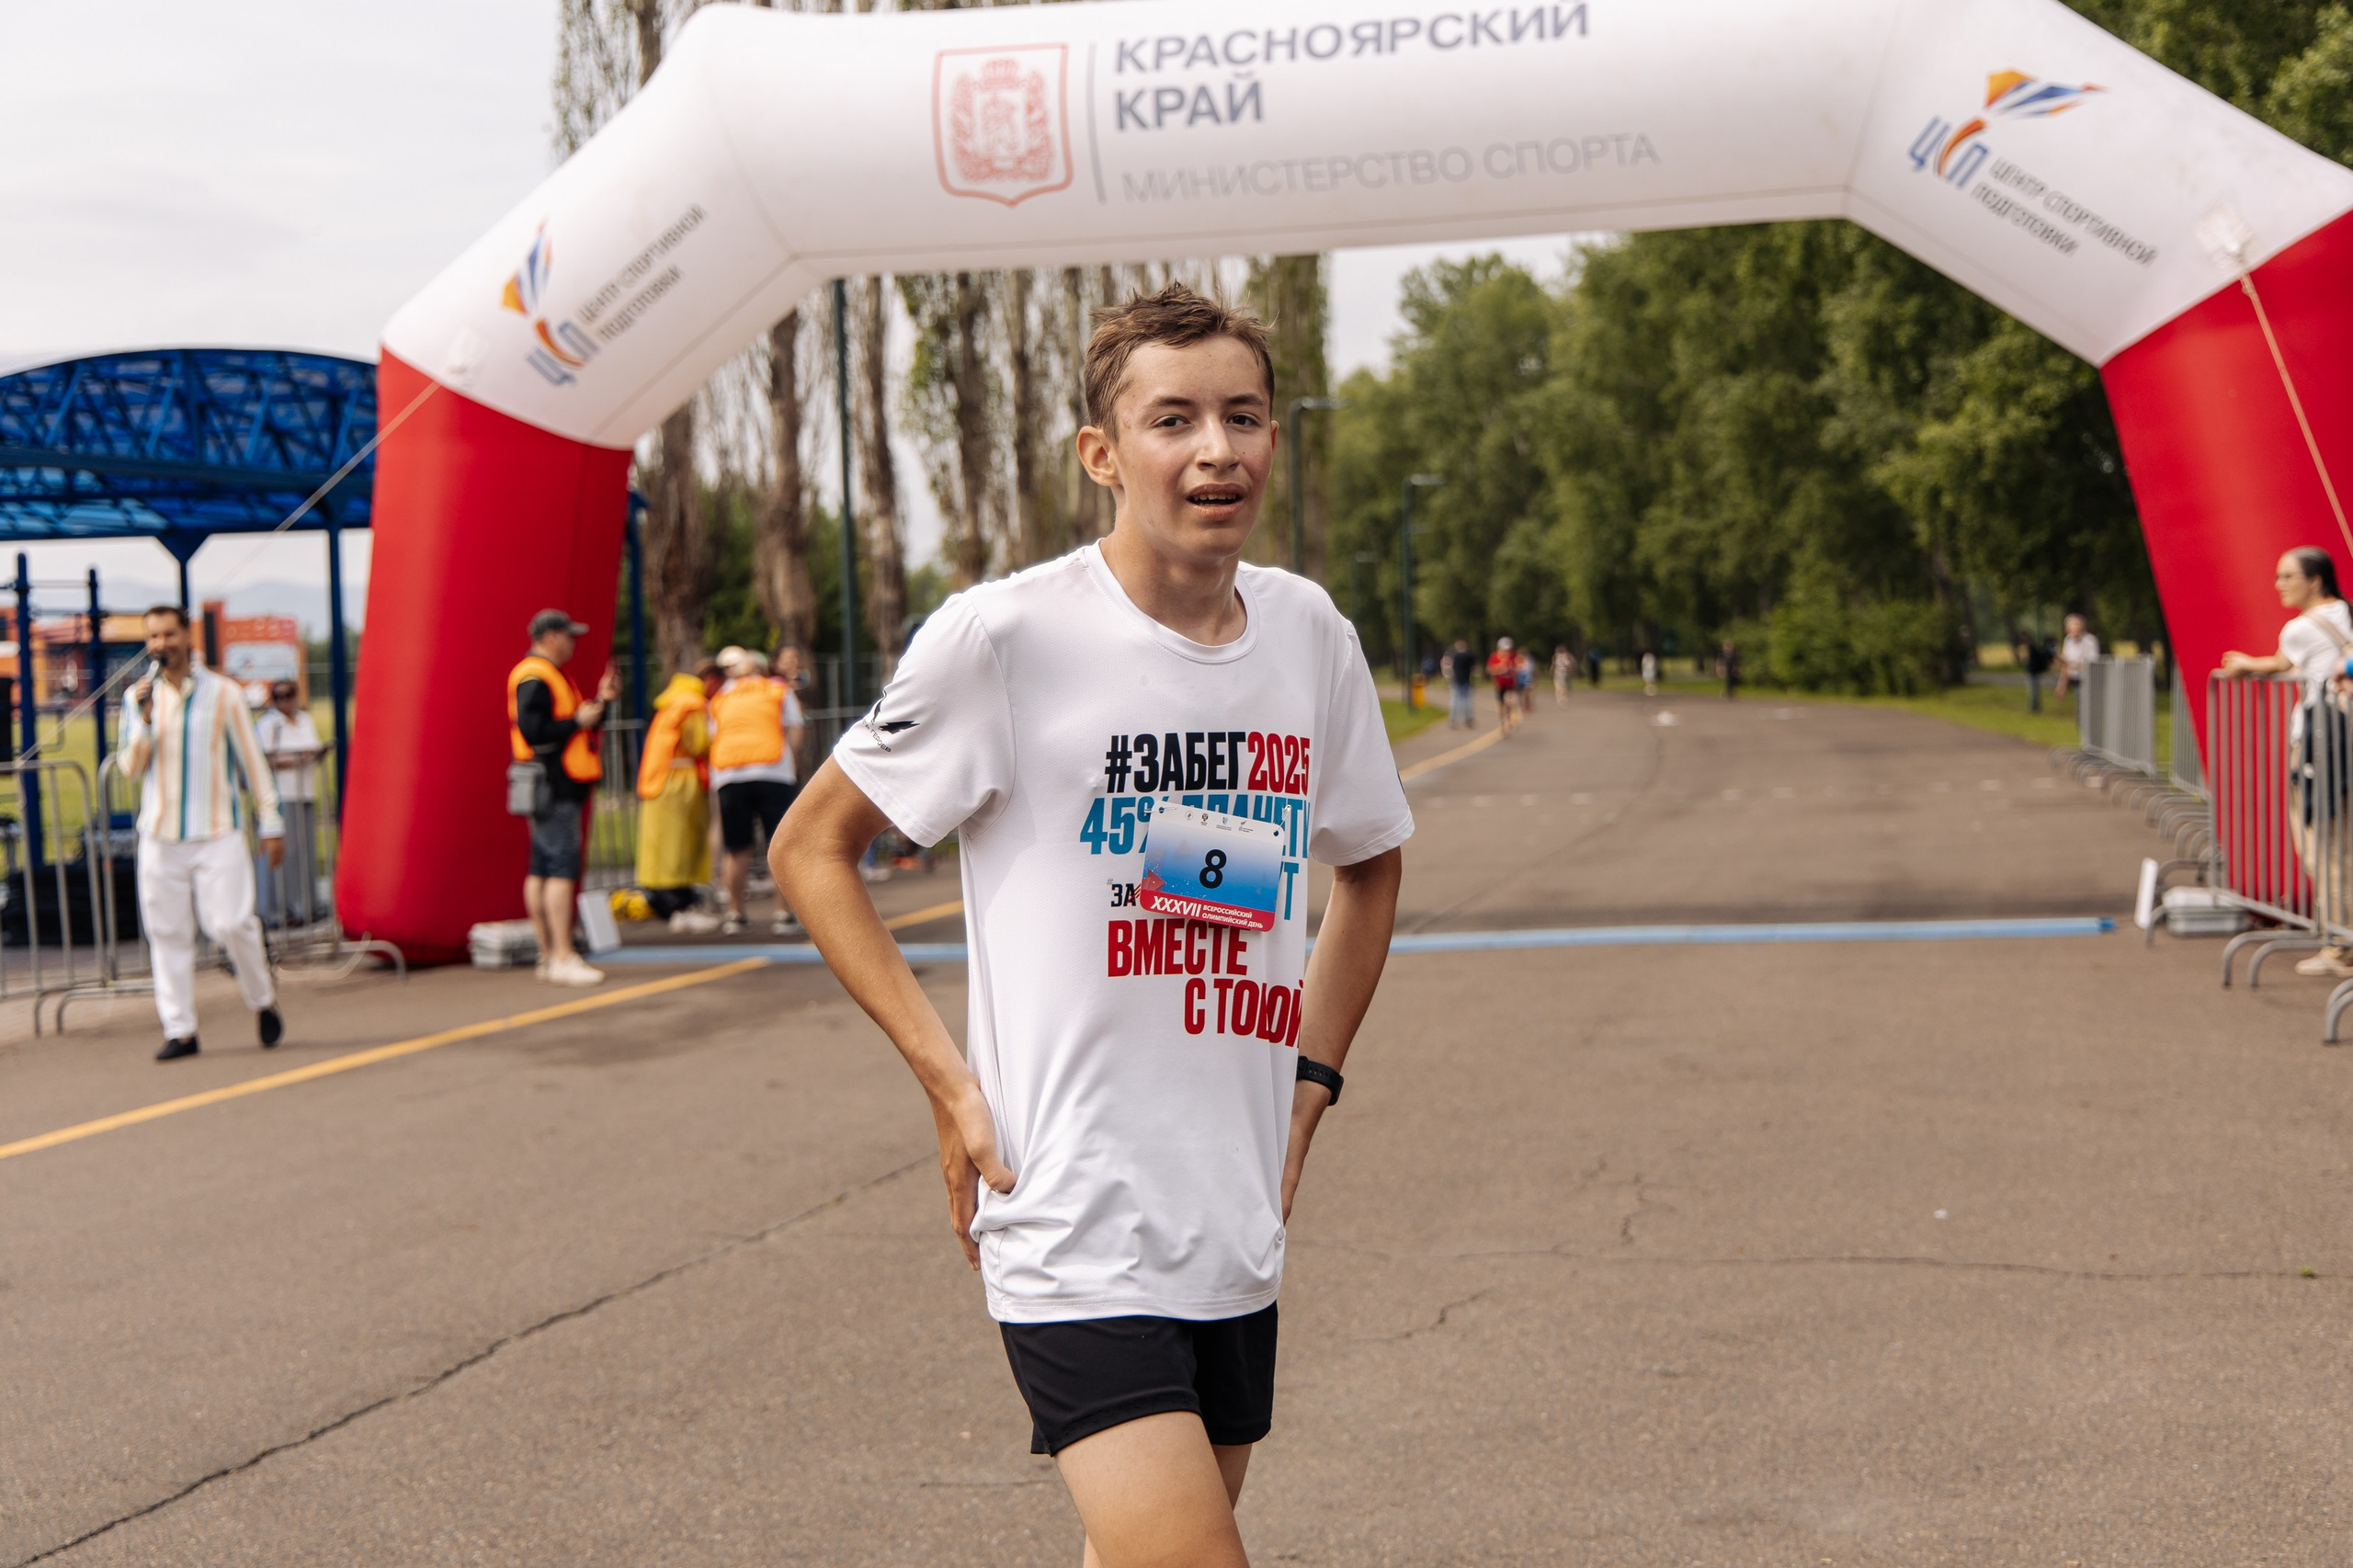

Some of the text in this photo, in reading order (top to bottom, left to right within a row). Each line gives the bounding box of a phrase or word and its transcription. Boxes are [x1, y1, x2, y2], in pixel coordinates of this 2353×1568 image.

[1115, 0, 1588, 74] КРАСНОЯРСКИЙ
[1115, 73, 1263, 131] КРАЙ
[1121, 131, 1662, 203] МИНИСТЕРСТВО СПОРТА
[1105, 731, 1310, 796] #ЗАБЕГ2025
[1199, 849, 1227, 889] 8
[1151, 895, 1201, 917] XXXVII
[1201, 912, 1264, 929] ОЛИМПИЙСКИЙ ДЕНЬ
[1202, 904, 1253, 919] ВСЕРОССИЙСКИЙ
[1108, 918, 1251, 977] ВМЕСТЕ
[1184, 978, 1206, 1035] С
